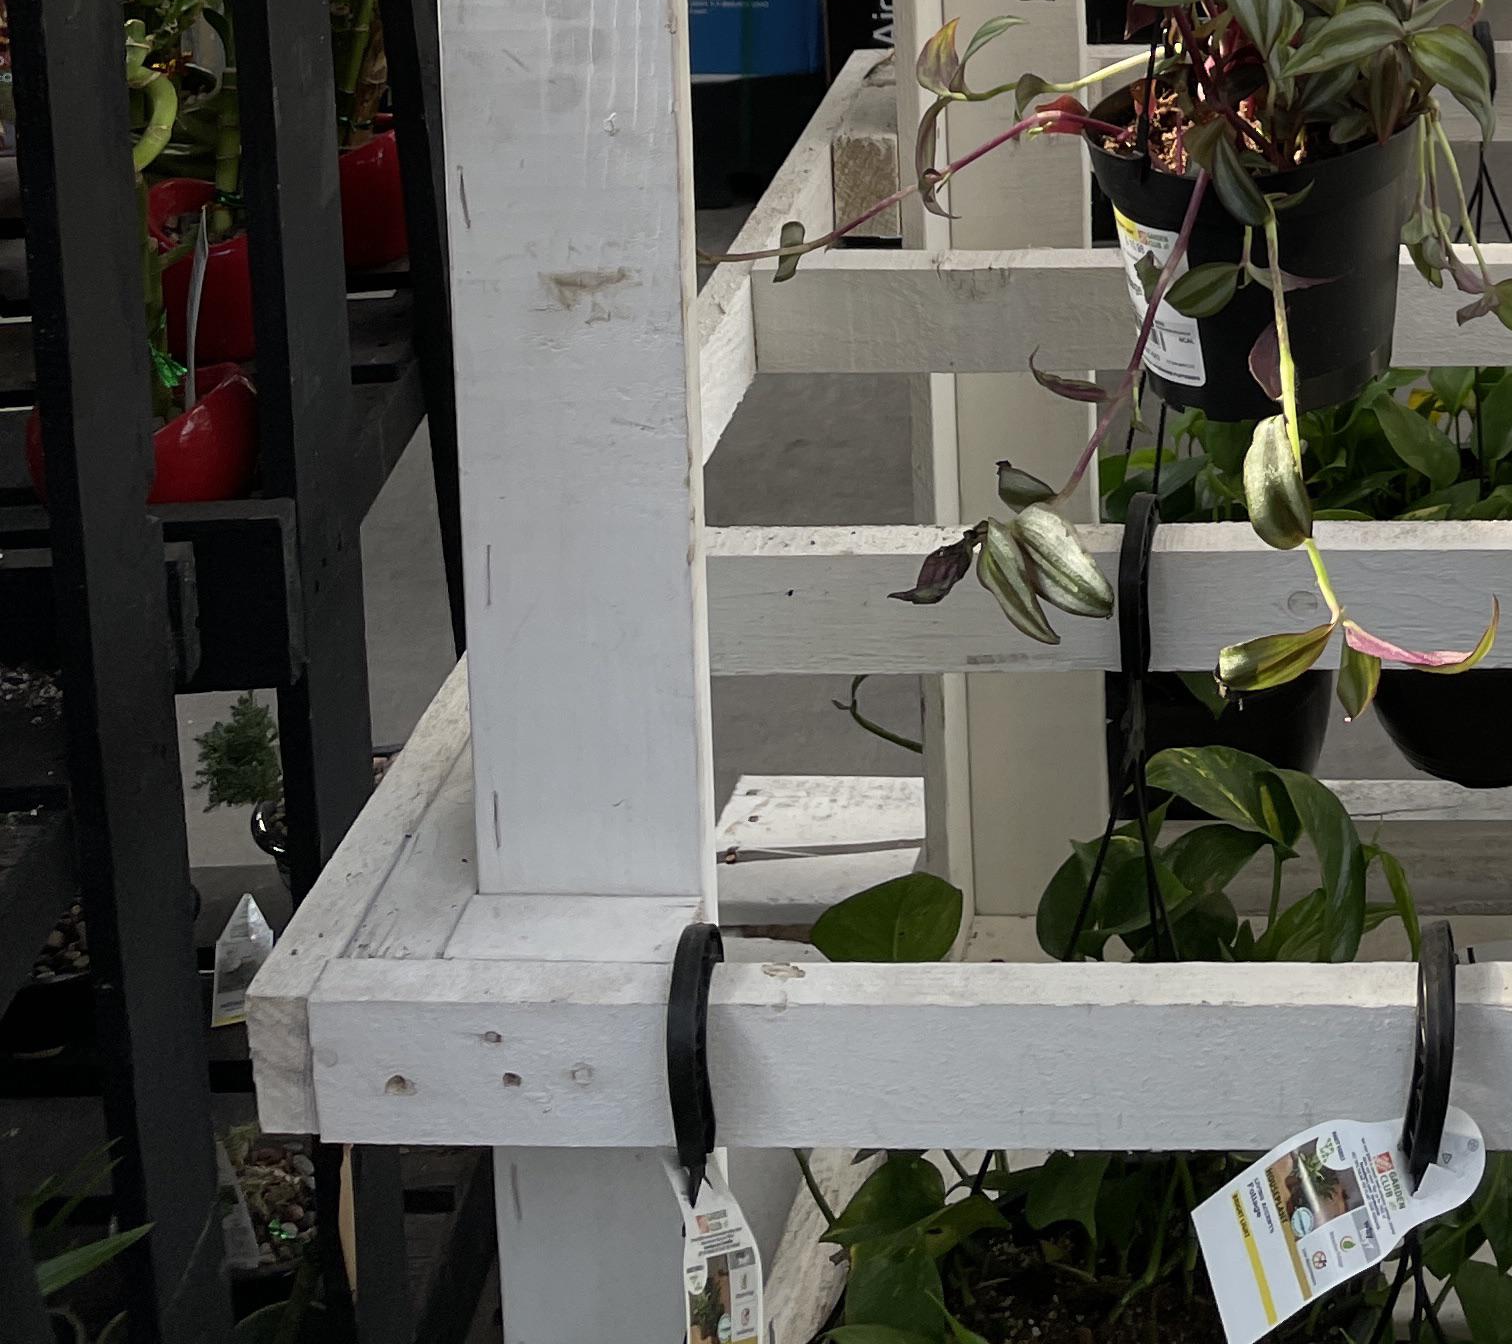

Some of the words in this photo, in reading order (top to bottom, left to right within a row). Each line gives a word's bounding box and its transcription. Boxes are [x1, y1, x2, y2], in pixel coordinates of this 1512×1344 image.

[1246, 1182, 1262, 1219] Foliage
[1264, 1168, 1289, 1225] HOUSEPLANT
[1380, 1175, 1393, 1199] CLUB
[1390, 1170, 1407, 1210] GARDEN
[1239, 1219, 1250, 1239] LIGHT
